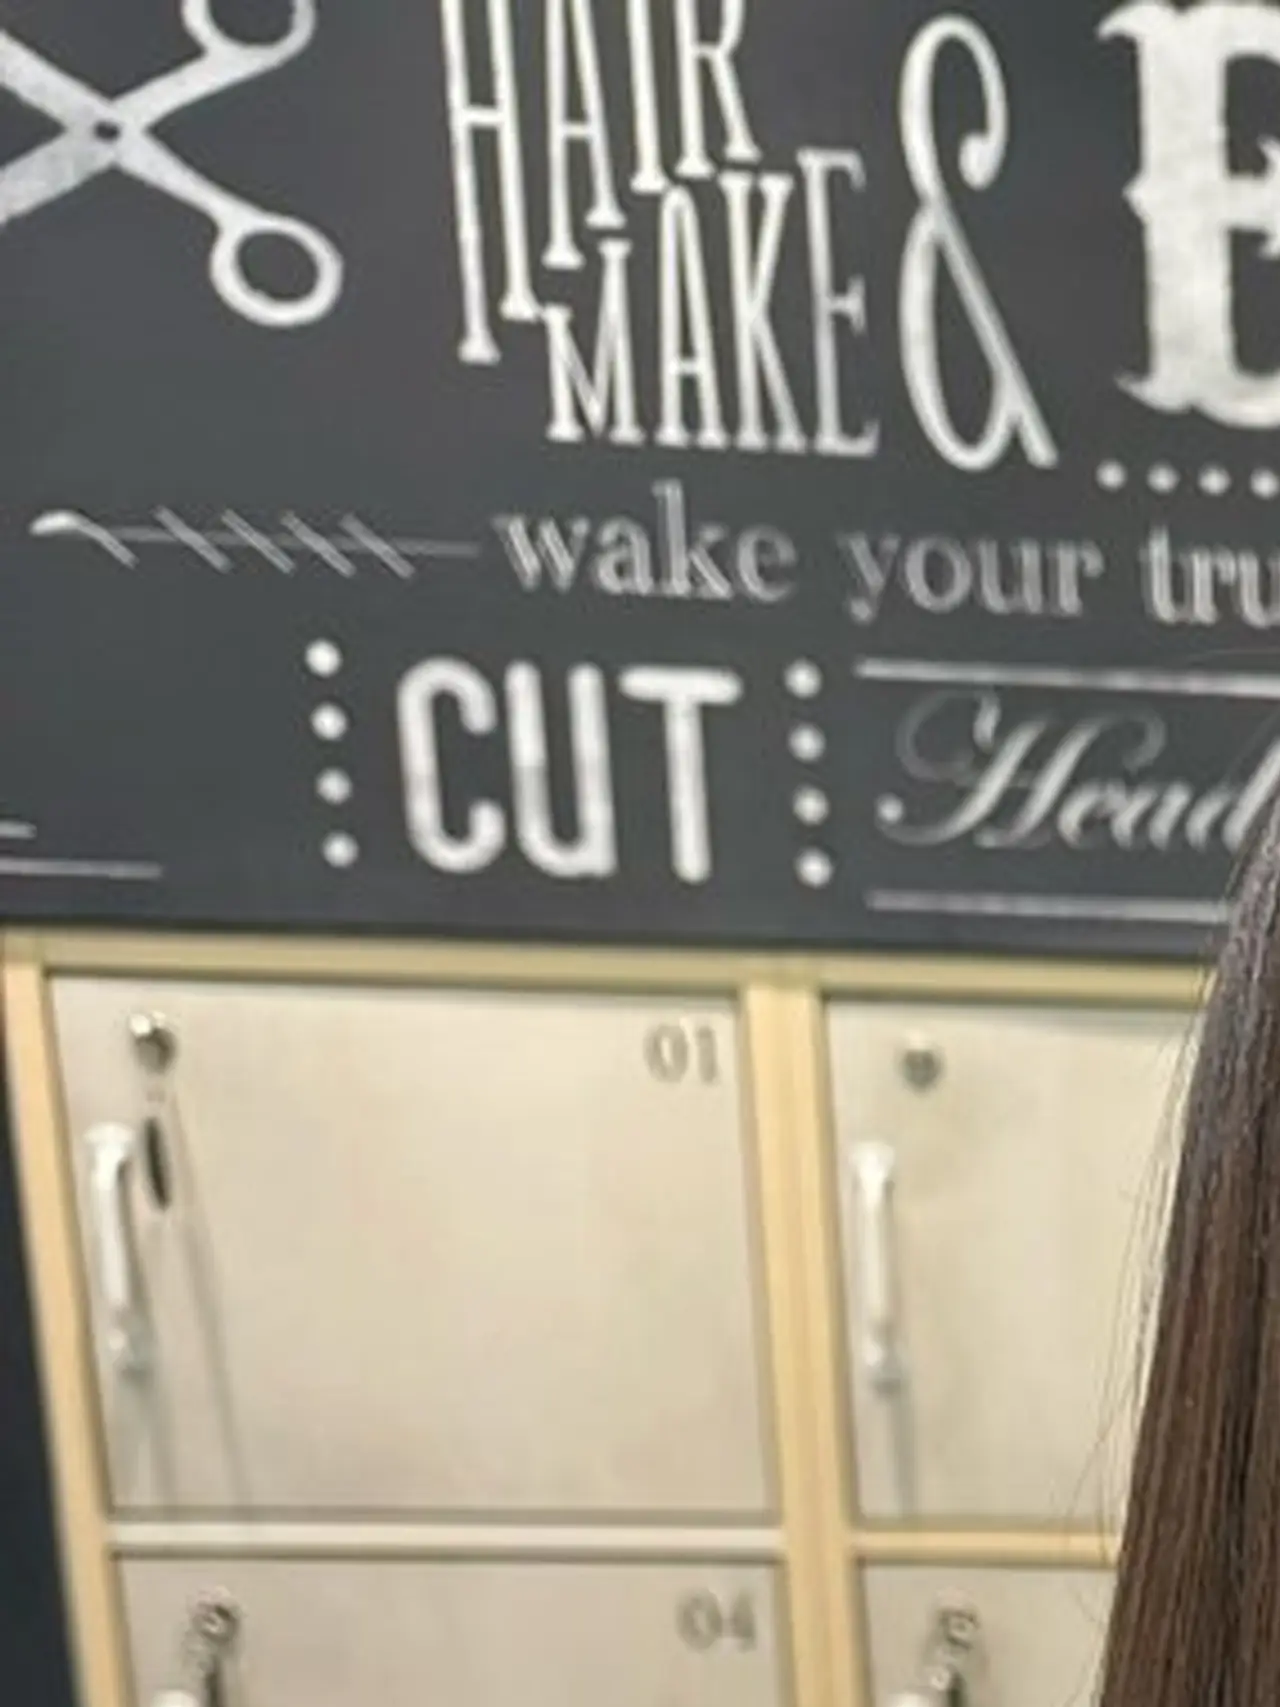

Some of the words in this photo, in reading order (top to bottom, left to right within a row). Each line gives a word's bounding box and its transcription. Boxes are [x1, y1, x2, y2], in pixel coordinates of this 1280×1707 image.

[440, 0, 762, 363] HAIR
[899, 14, 1060, 471] &
[541, 146, 880, 458] MAKE
[492, 478, 799, 601] wake
[842, 526, 1105, 624] your
[396, 656, 745, 883] CUT
[642, 1023, 721, 1087] 01
[676, 1589, 757, 1654] 04
